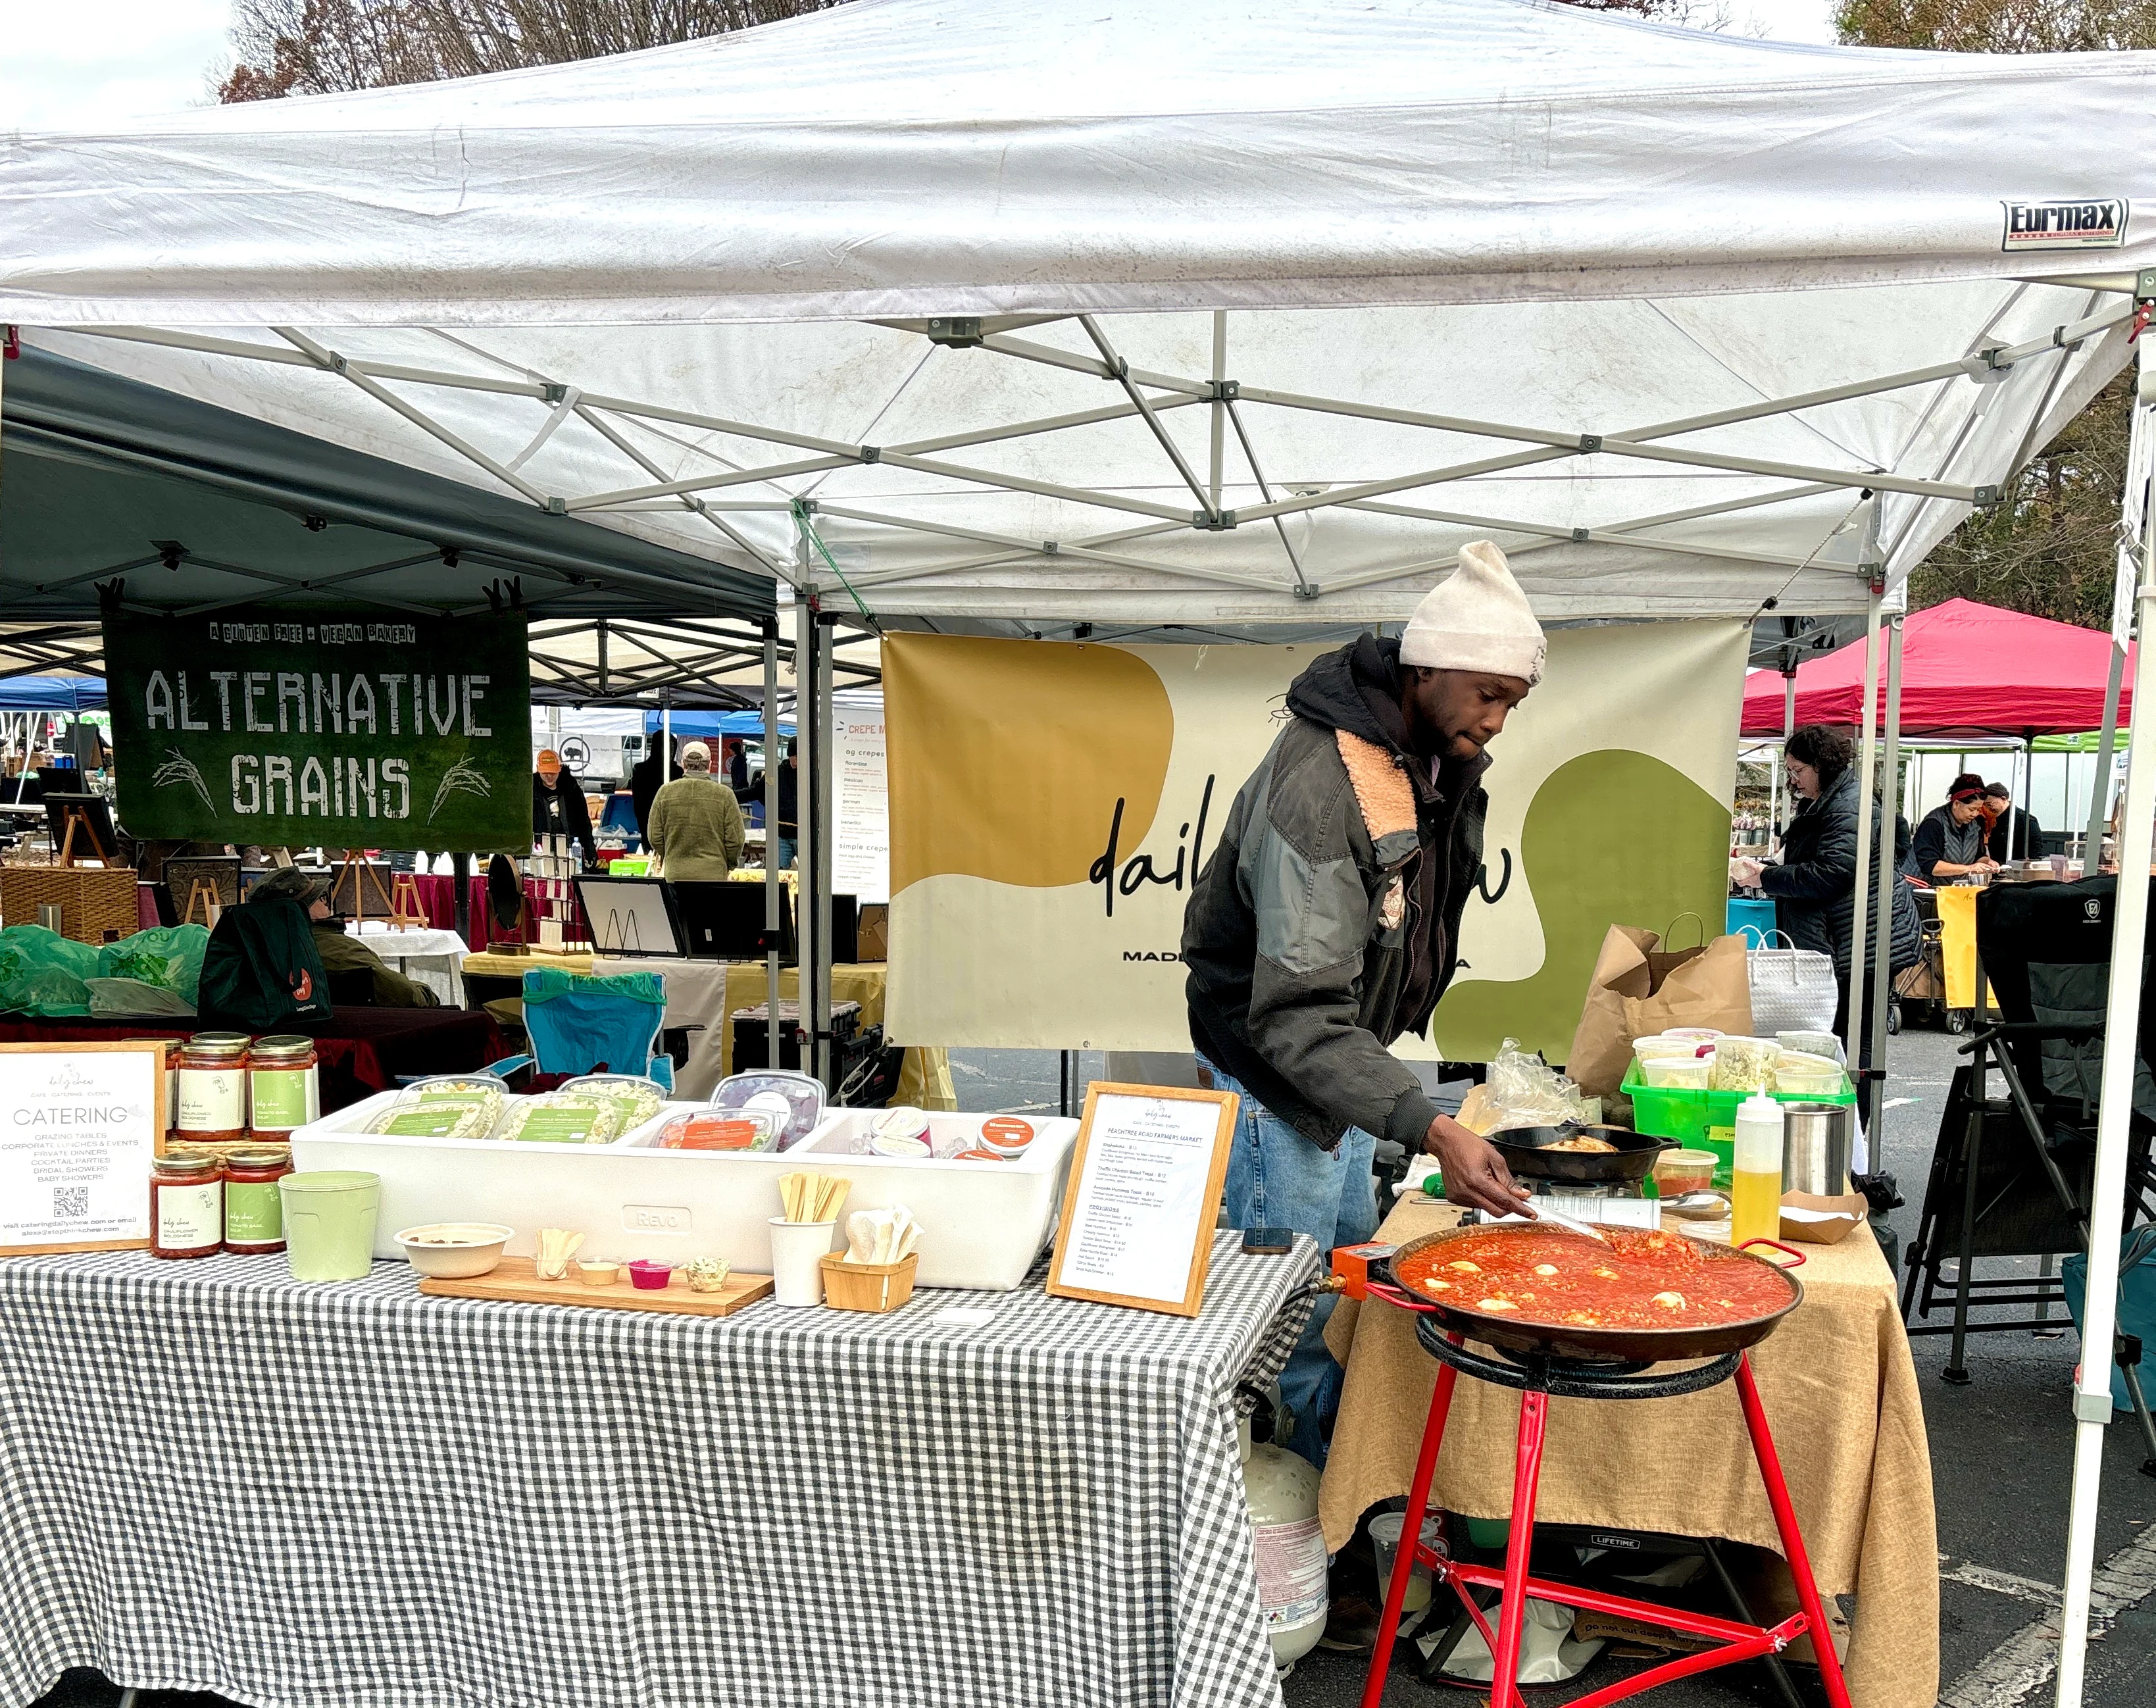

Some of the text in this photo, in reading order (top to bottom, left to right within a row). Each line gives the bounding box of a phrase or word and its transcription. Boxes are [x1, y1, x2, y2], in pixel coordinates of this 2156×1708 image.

[2011, 204, 2115, 232] Eurmax
[210, 622, 218, 640] A
[223, 624, 269, 643] GLUTEN
[274, 624, 302, 641] FREE
[320, 624, 363, 644] VEGAN
[368, 624, 416, 644] BAKERY
[145, 670, 492, 737] ALTERNATIVE
[849, 725, 876, 734] CREPE
[231, 755, 410, 819] GRAINS
[1089, 774, 1215, 918] dail
[49, 1074, 70, 1090] daily
[13, 1107, 128, 1125] CATERING
[1107, 1128, 1138, 1136] PEACHTREE
[1180, 1135, 1203, 1143] MARKET
[1596, 1537, 1635, 1548] LIFETIME
[1640, 1628, 1666, 1640] deep
